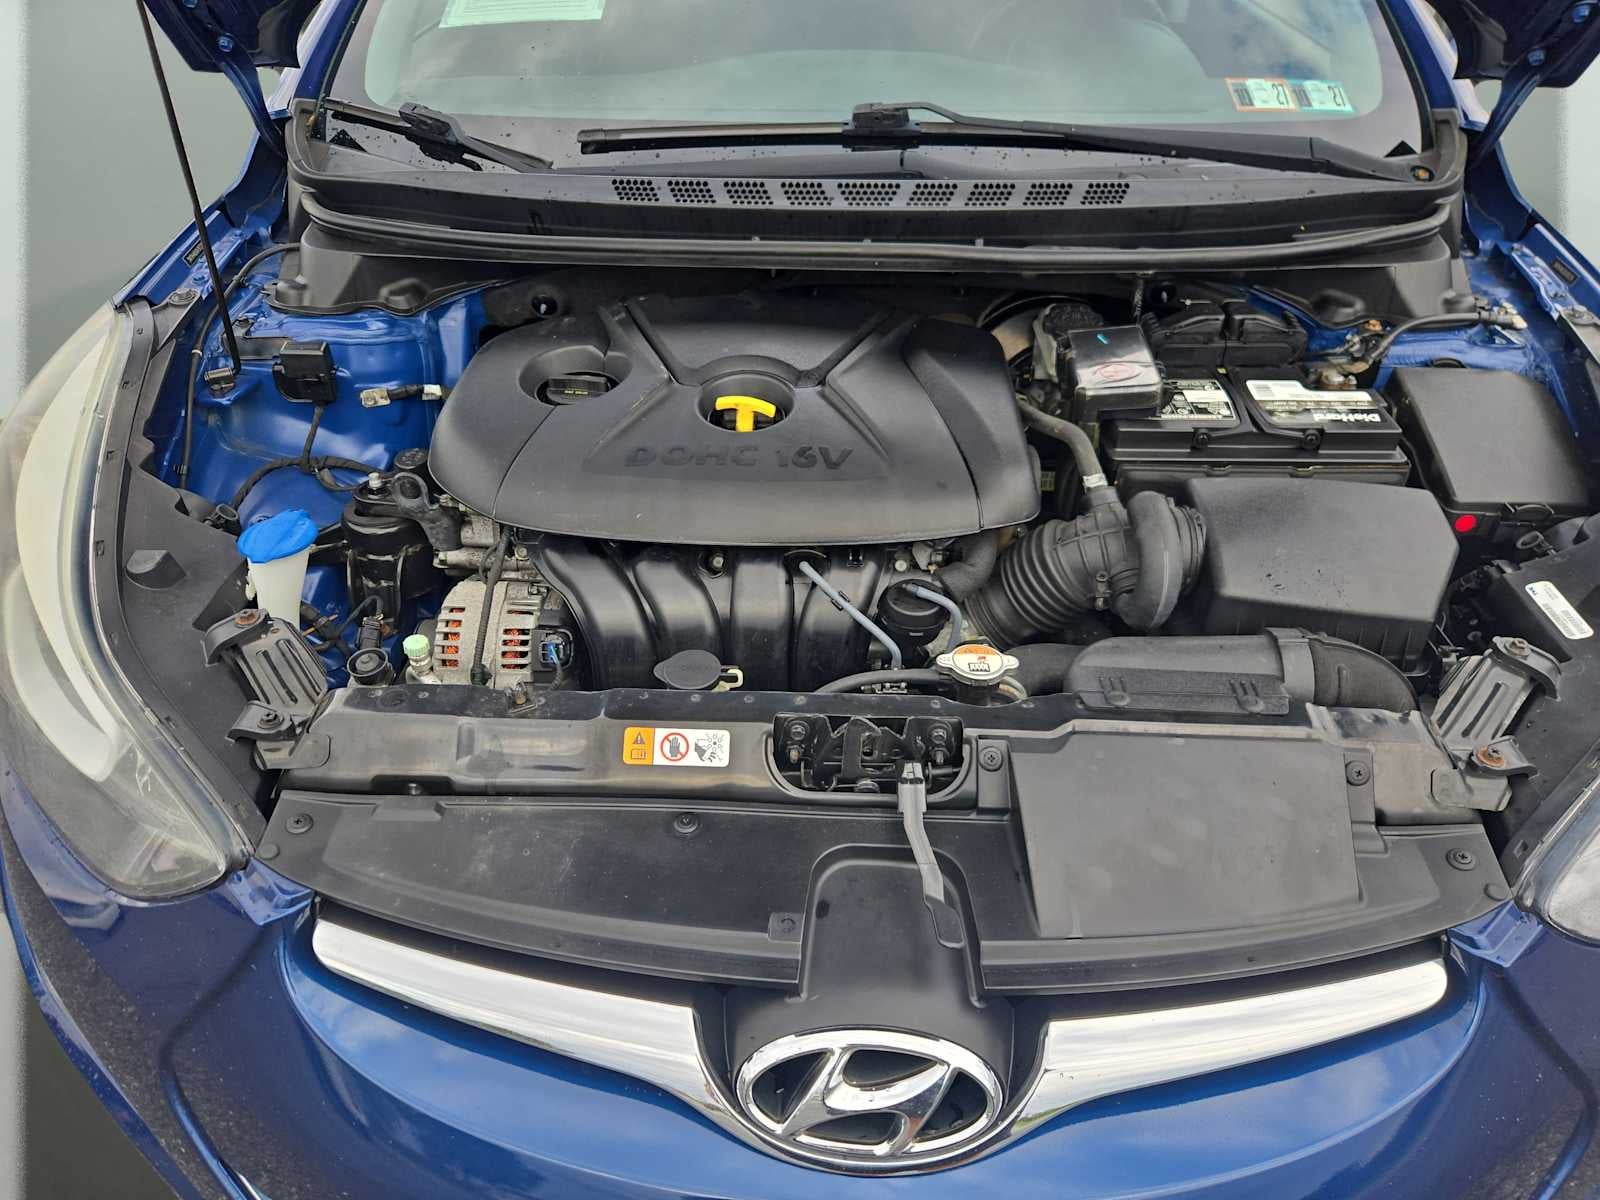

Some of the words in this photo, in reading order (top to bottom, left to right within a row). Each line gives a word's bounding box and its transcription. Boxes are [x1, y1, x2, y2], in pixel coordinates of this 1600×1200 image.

[1312, 413, 1381, 422] DieHard
[624, 446, 758, 468] DOHC
[775, 446, 854, 469] 16V
